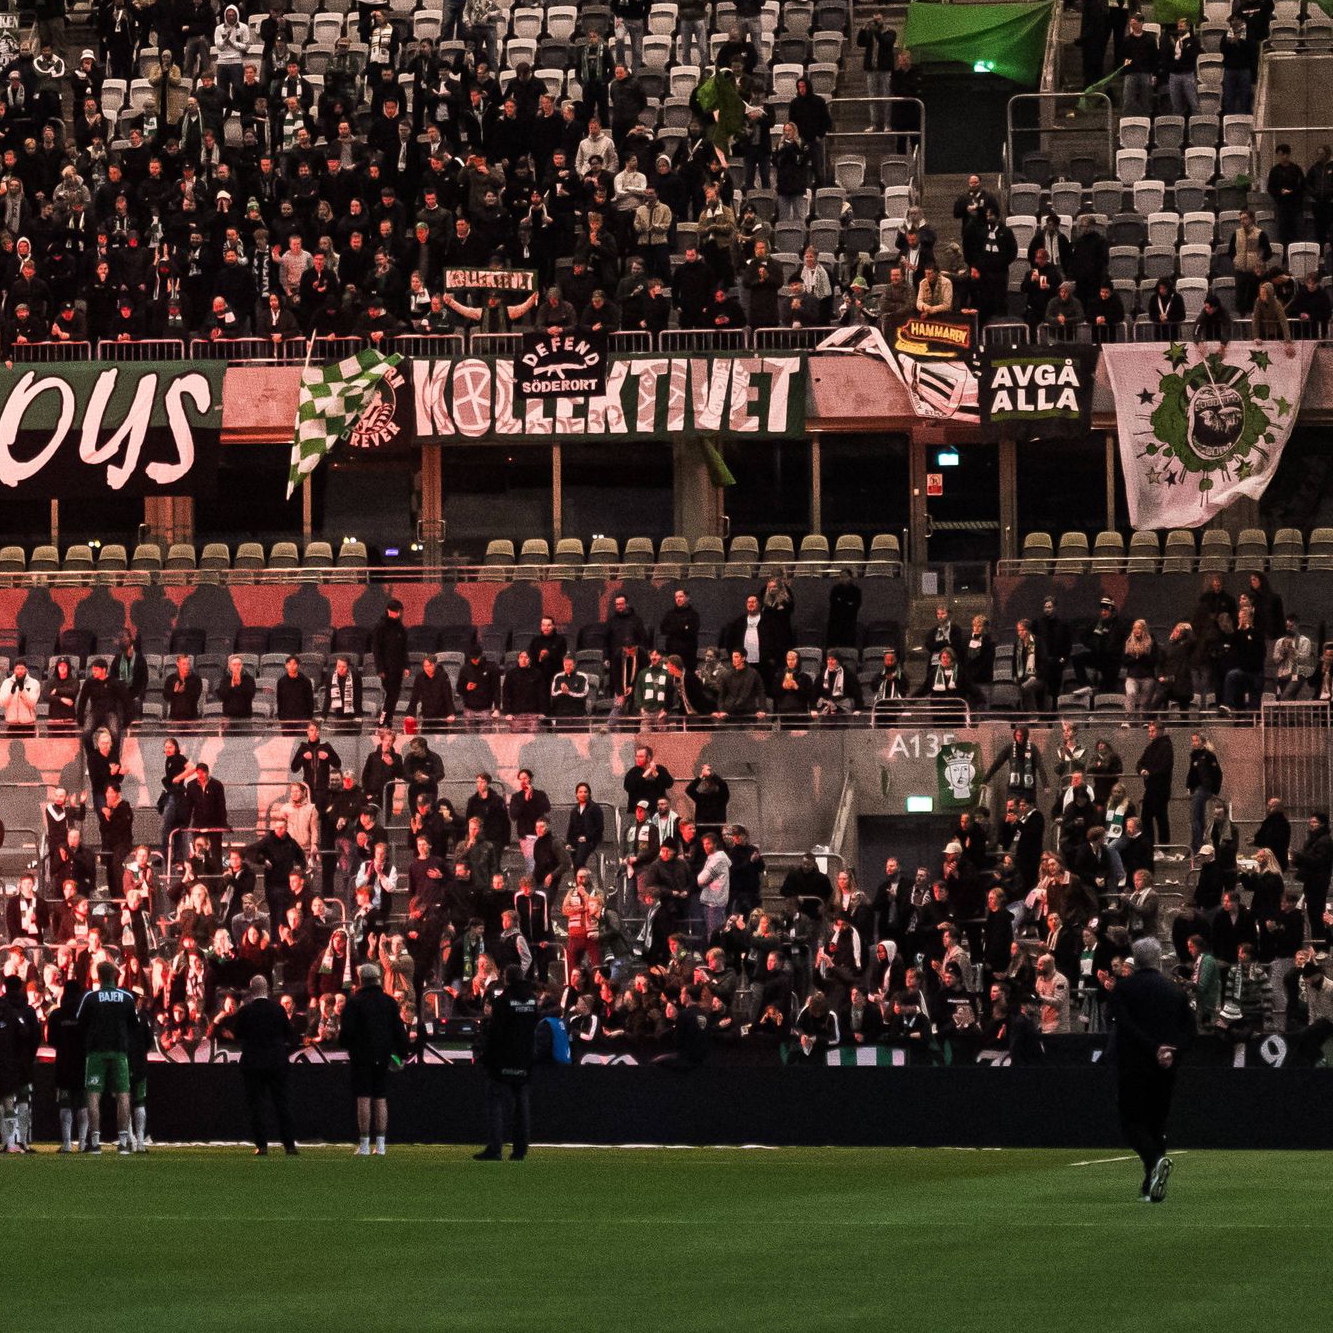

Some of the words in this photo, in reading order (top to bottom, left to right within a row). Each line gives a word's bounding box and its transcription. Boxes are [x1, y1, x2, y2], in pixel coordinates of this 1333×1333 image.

[910, 322, 968, 344] HAMMARBY
[522, 335, 600, 367] DEFEND
[521, 376, 598, 394] SÖDERORT
[990, 358, 1081, 389] AVGÅ
[990, 387, 1080, 414] ALLA
[98, 991, 124, 1003] BAJEN
